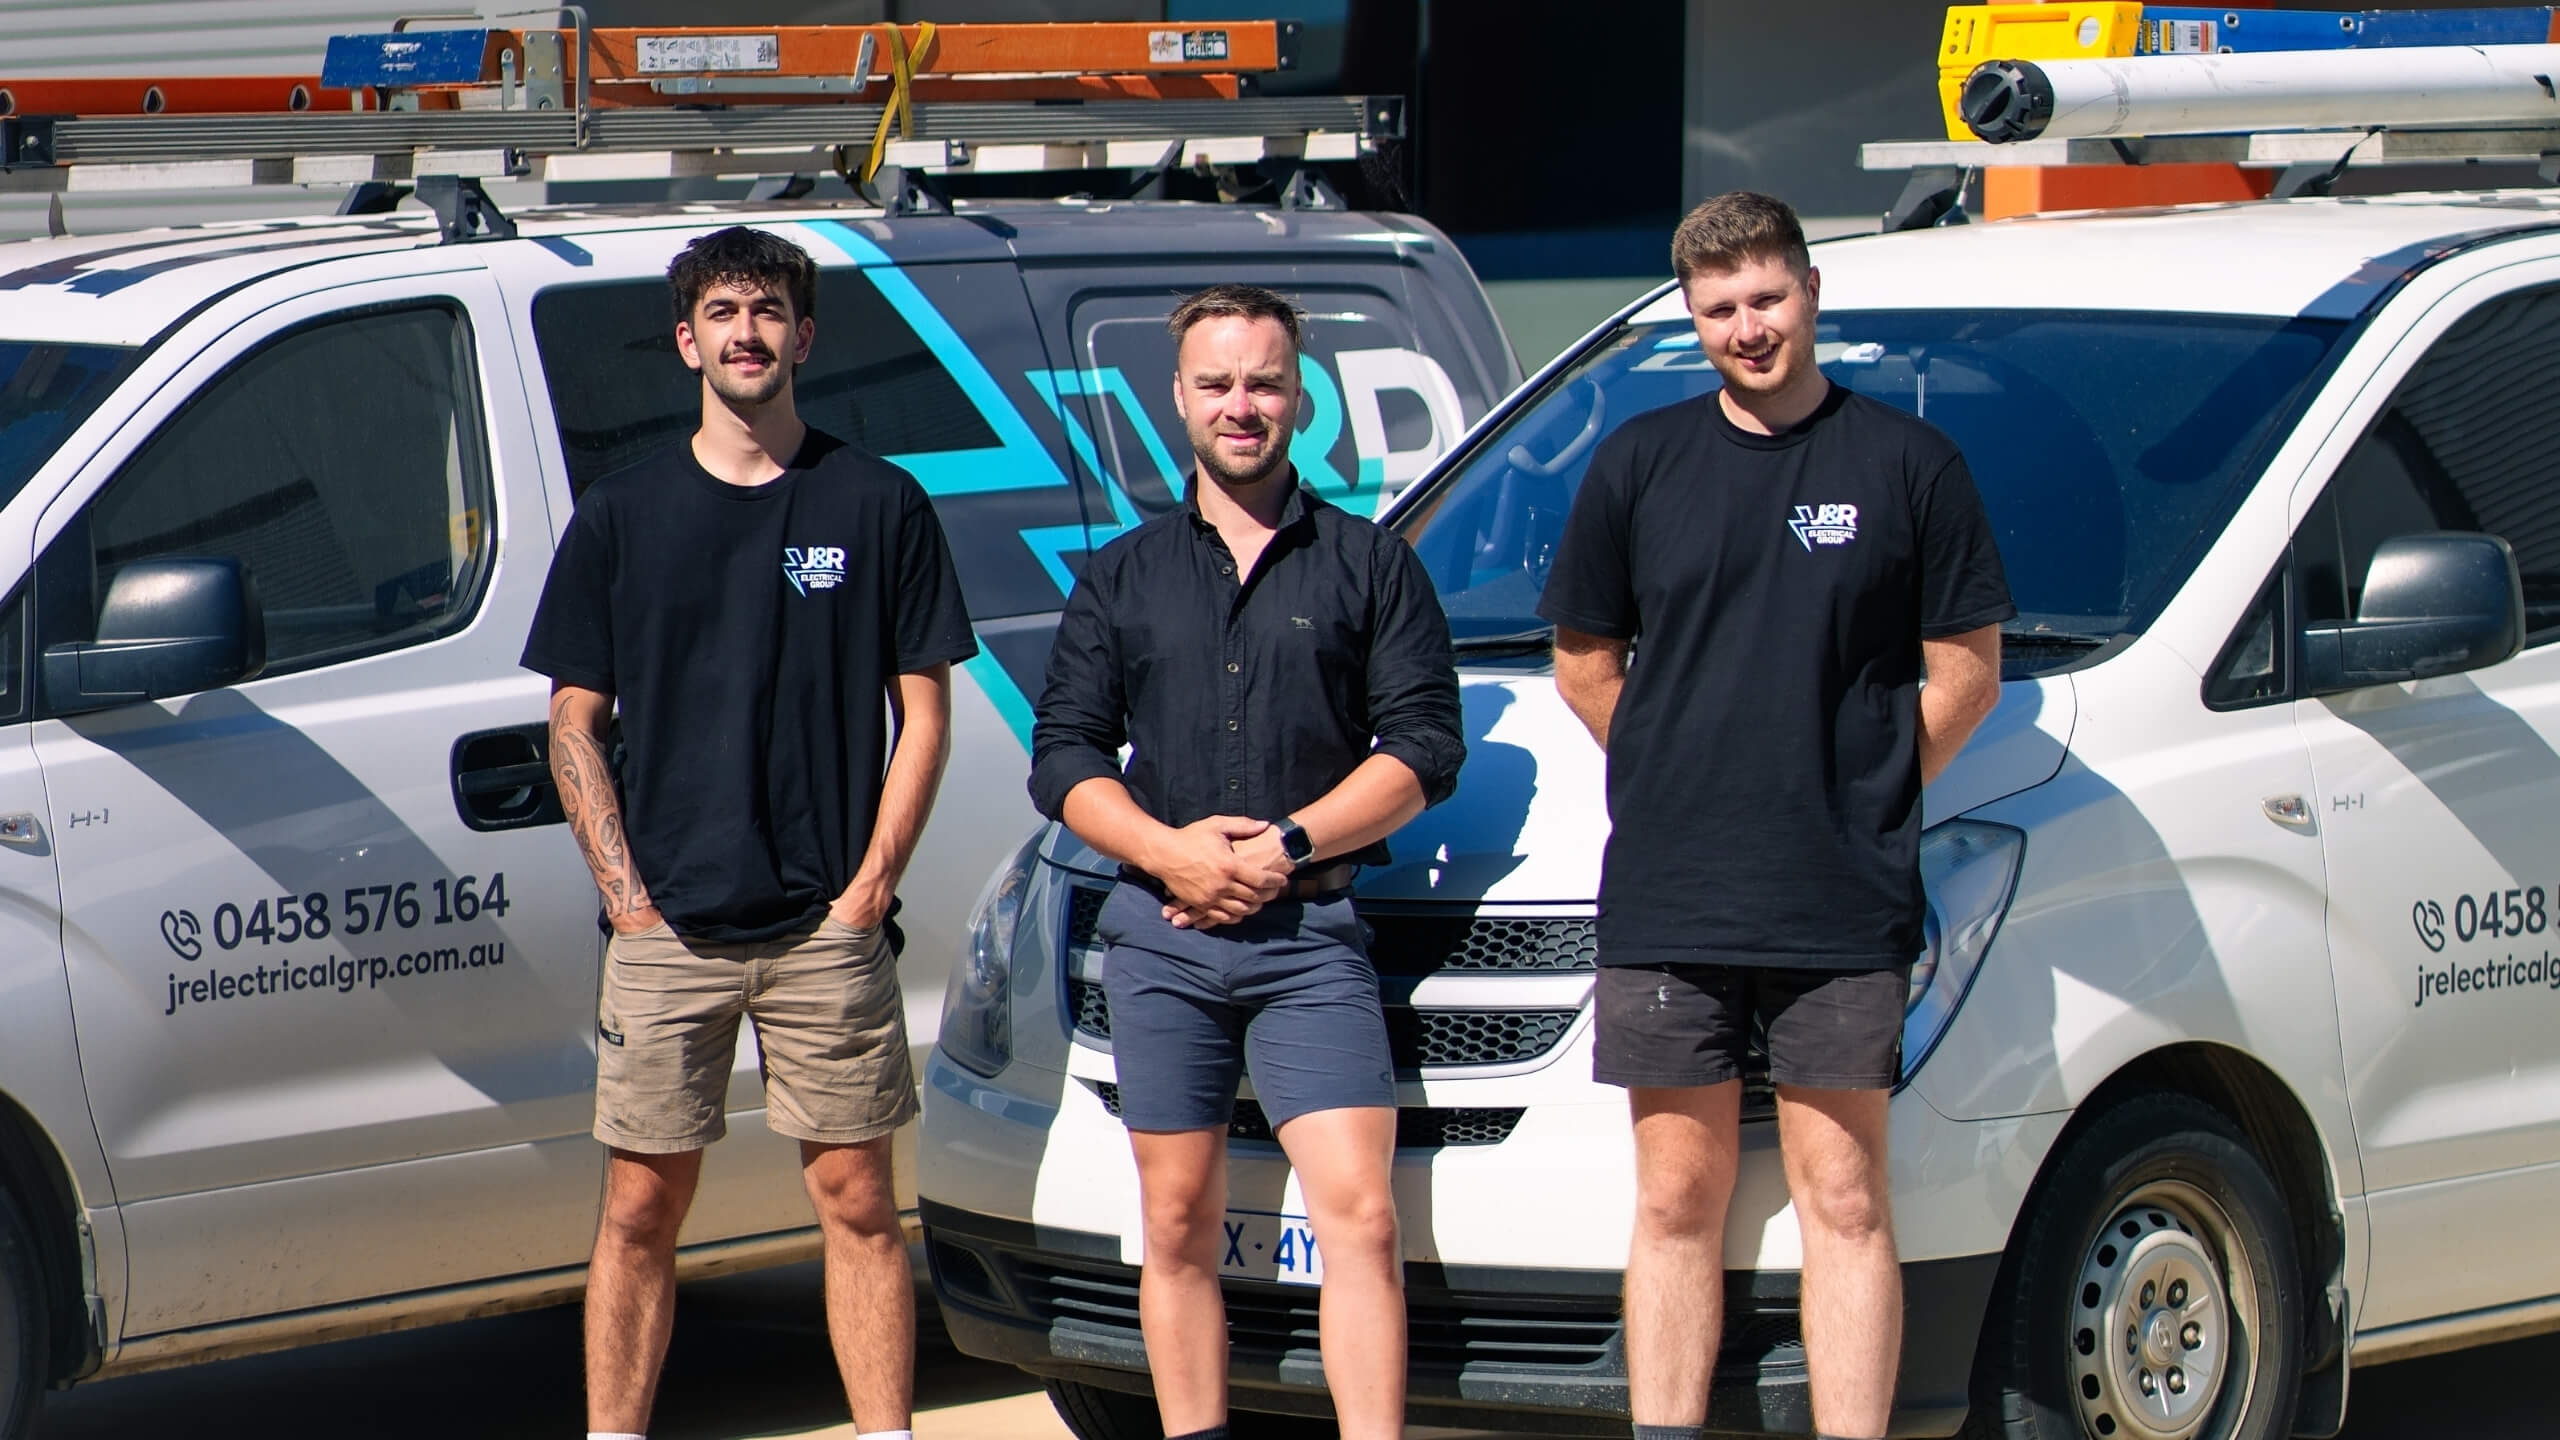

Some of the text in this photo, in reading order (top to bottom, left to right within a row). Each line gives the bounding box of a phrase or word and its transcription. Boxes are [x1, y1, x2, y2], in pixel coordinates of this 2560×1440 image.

[1810, 504, 1858, 527] J&R
[1808, 530, 1855, 539] ELECTRICAL
[801, 547, 845, 570] J&R
[800, 574, 844, 583] ELECTRICAL
[810, 581, 836, 589] GROUP
[213, 873, 510, 950] 0458 576 164
[2454, 886, 2547, 943] 0458
[165, 942, 505, 1016] jrelectricalgrp.com.au
